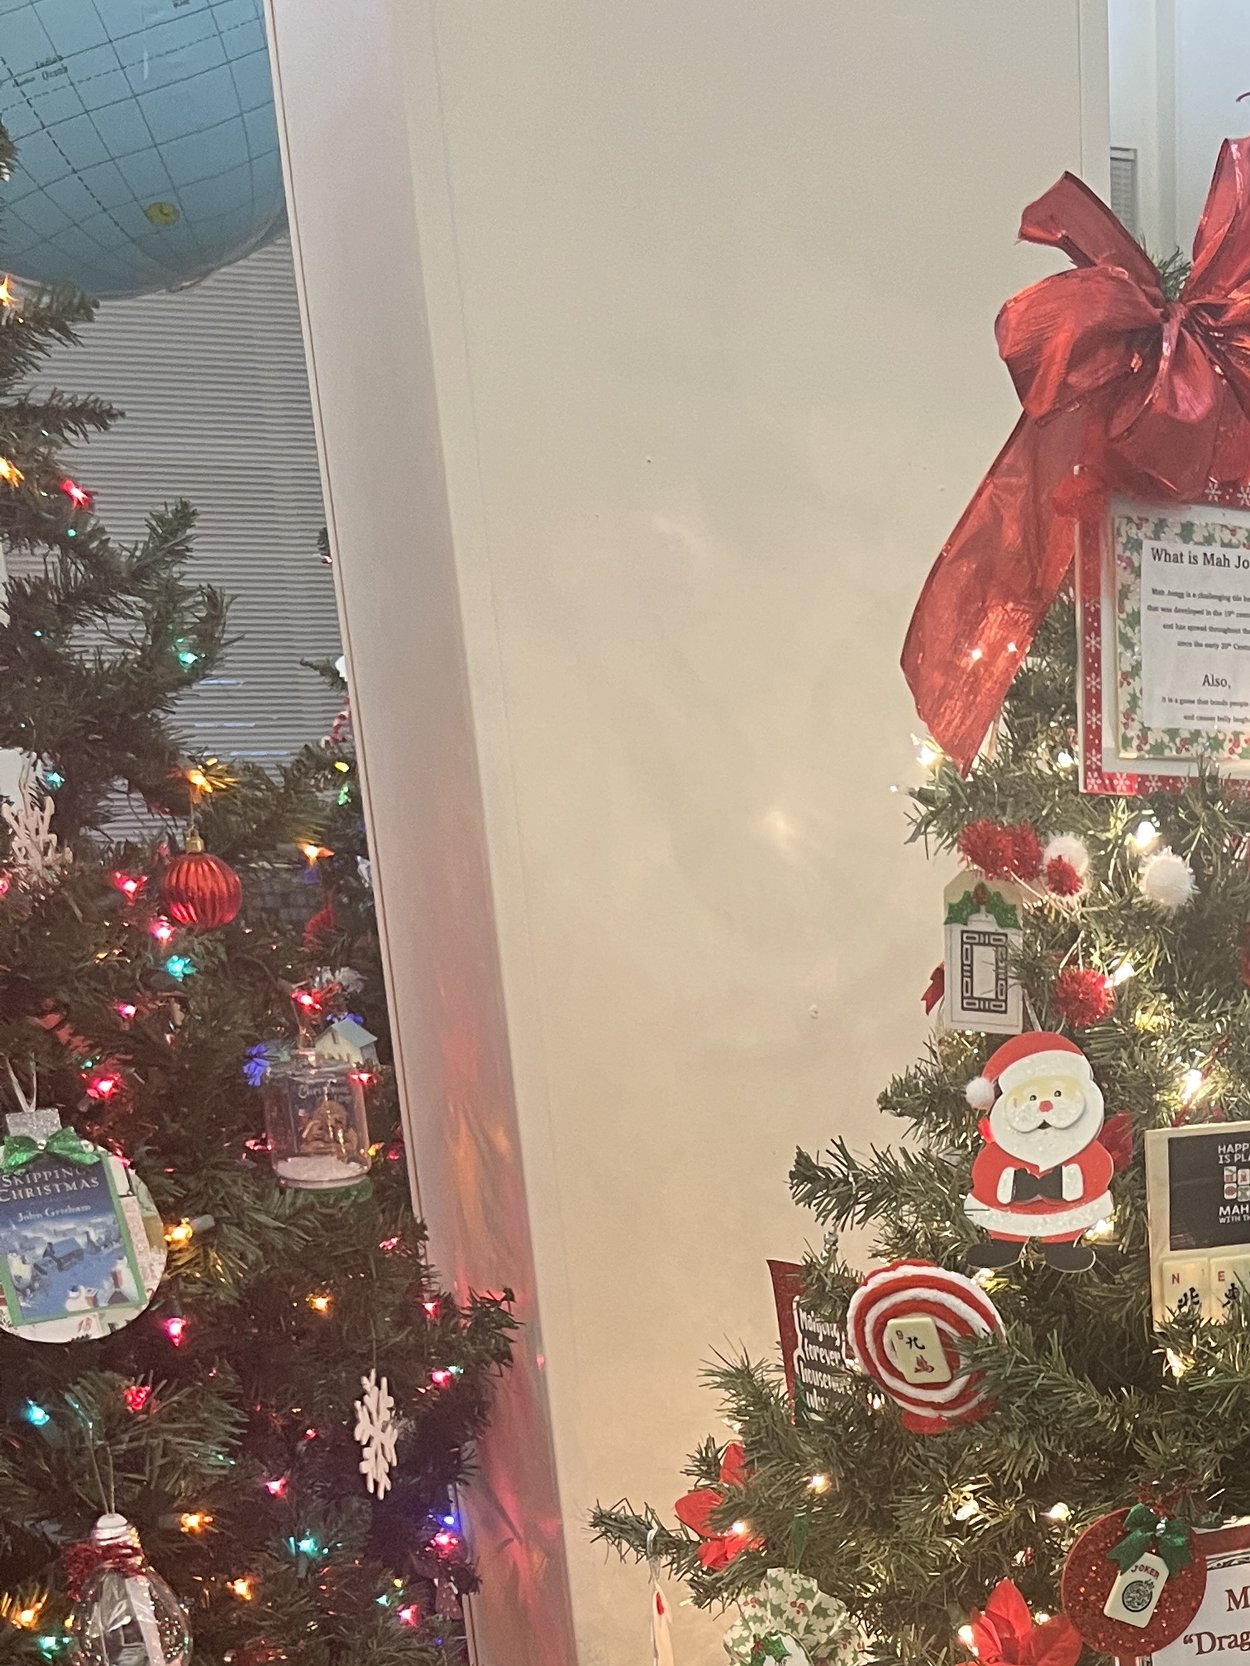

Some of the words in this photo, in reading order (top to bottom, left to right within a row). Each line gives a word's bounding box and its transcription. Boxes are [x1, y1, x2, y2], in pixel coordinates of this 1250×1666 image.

[1151, 547, 1184, 565] What
[1188, 551, 1199, 565] is
[1203, 552, 1231, 568] Mah
[1151, 588, 1165, 596] Mah
[1198, 592, 1231, 602] challenging
[1174, 606, 1204, 616] developed
[1208, 626, 1241, 635] throughout
[1205, 642, 1219, 650] early
[1202, 674, 1231, 689] Also,
[1218, 1152, 1231, 1164] IS
[0, 1177, 100, 1202] CHRISTMAS
[17, 1211, 43, 1223] John
[1218, 1214, 1241, 1224] WITH
[1171, 1273, 1180, 1284] N
[1217, 1270, 1226, 1282] E
[1131, 1564, 1160, 1581] JOKER
